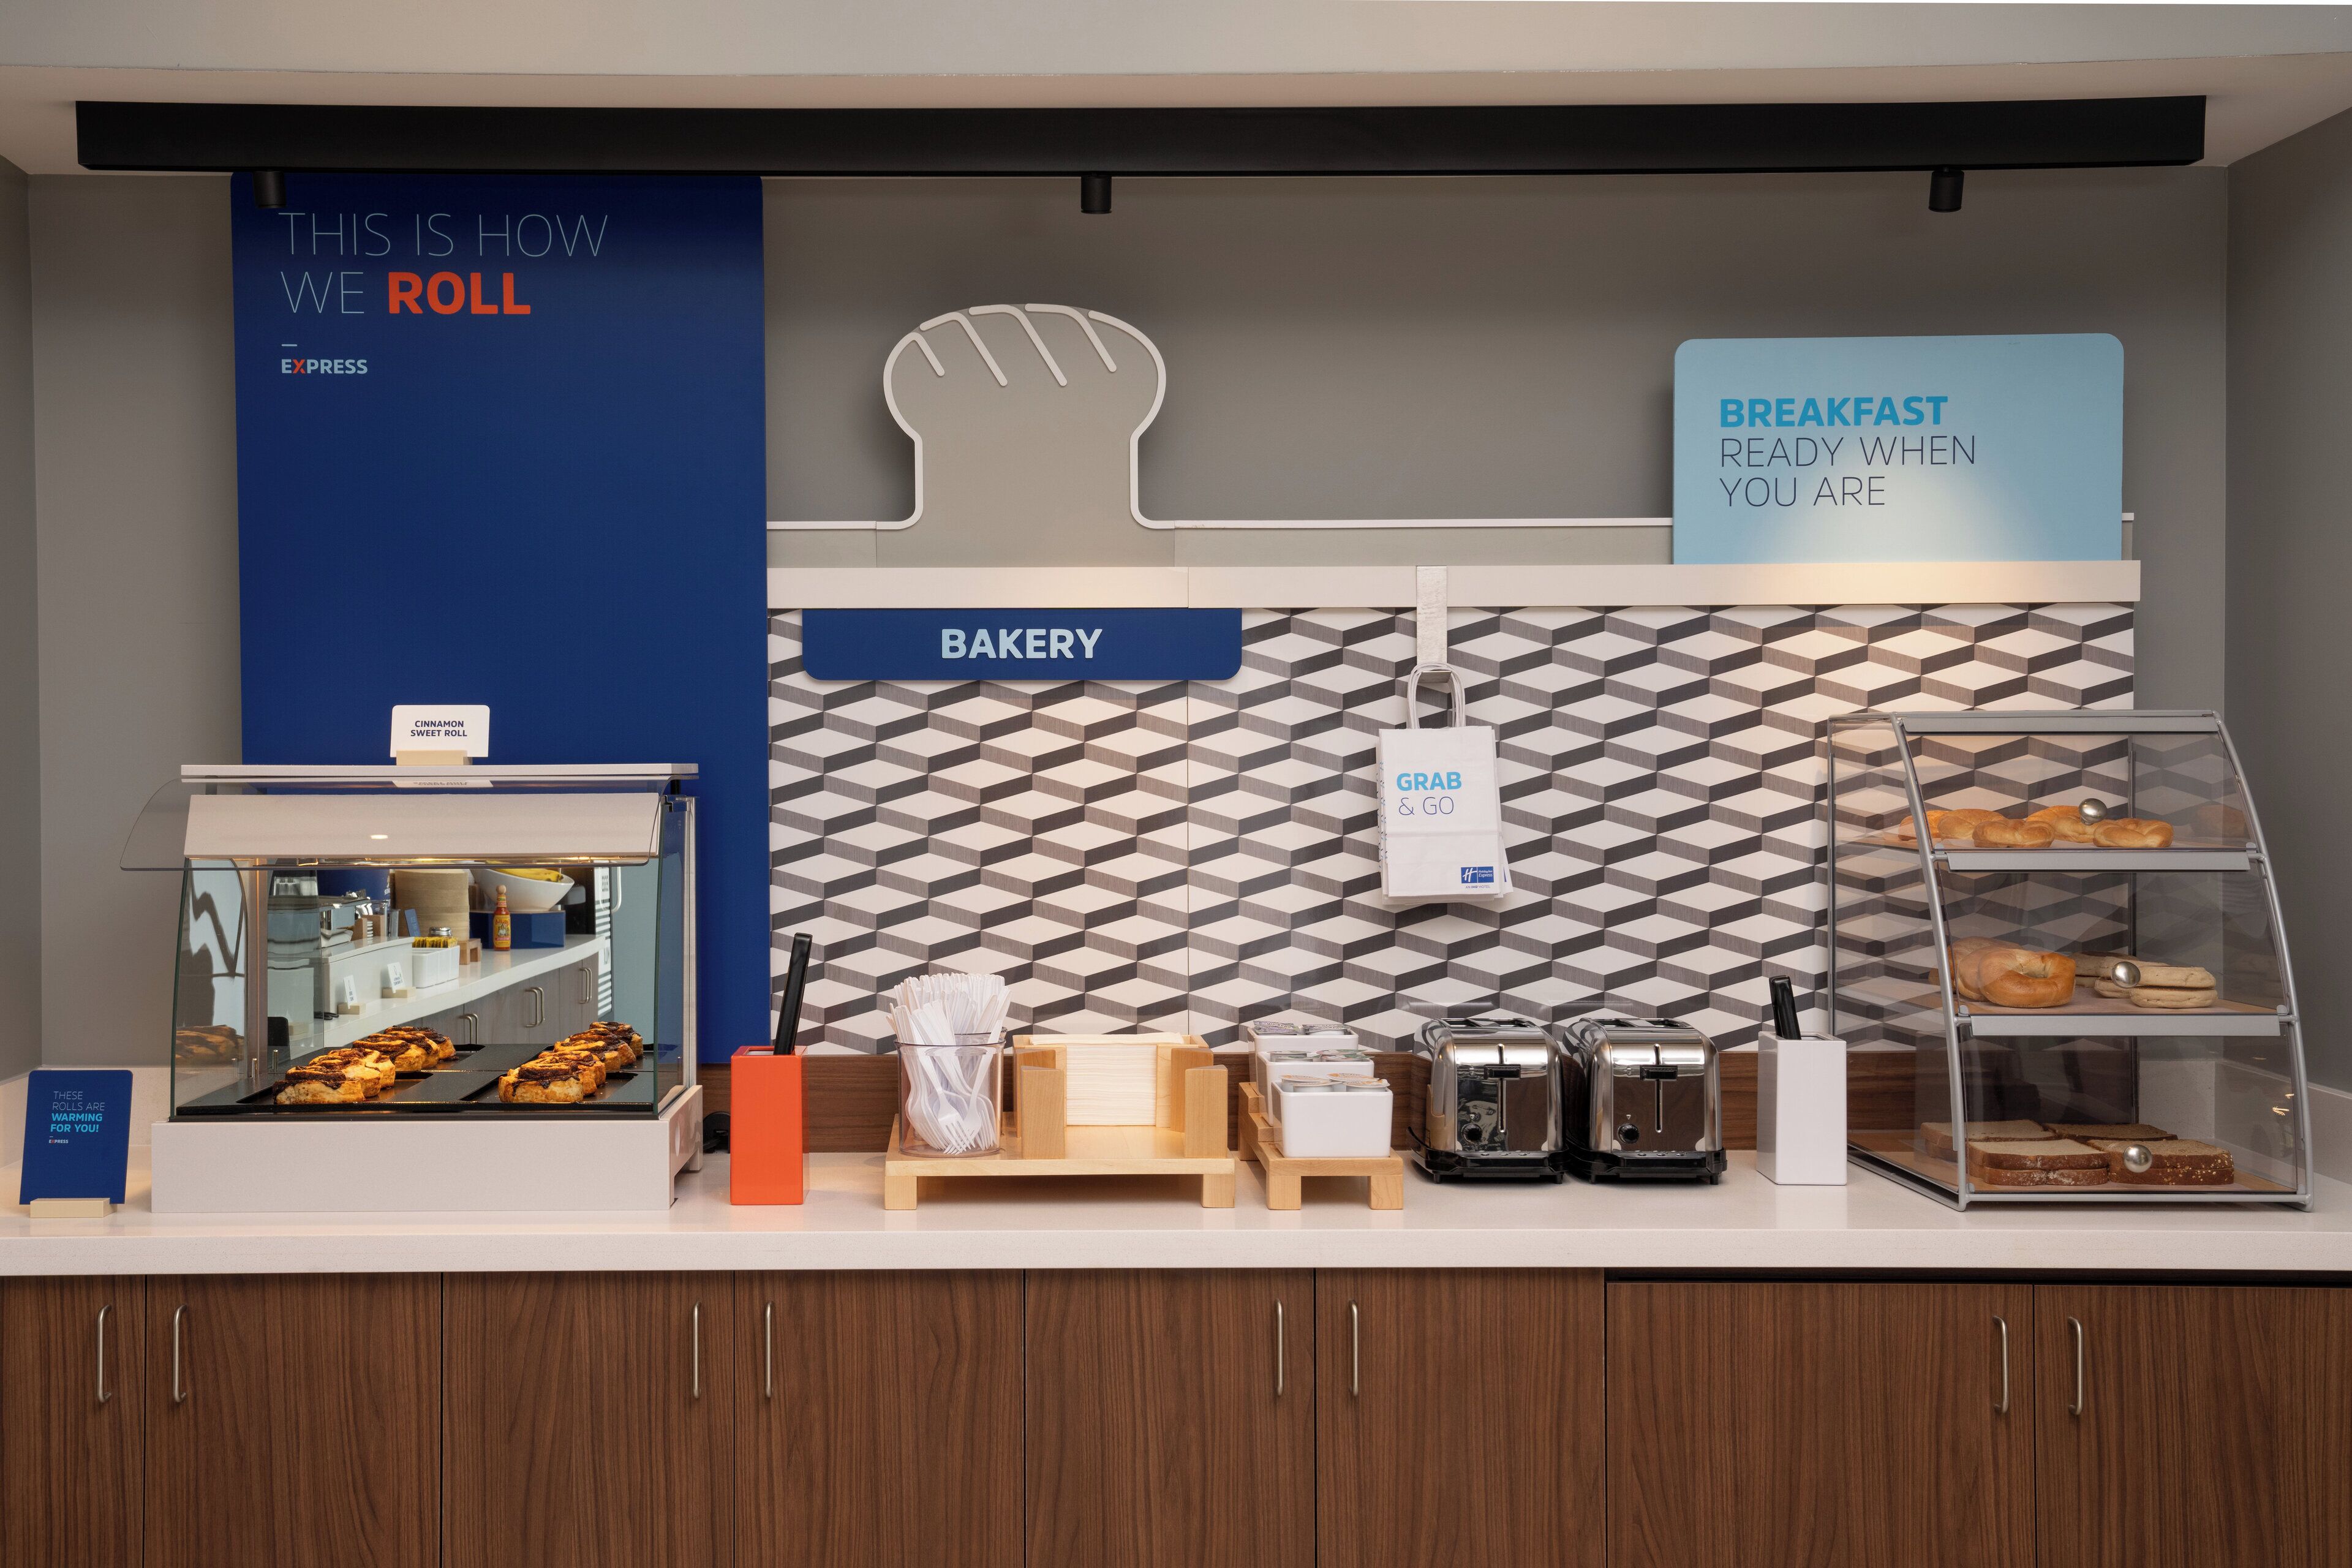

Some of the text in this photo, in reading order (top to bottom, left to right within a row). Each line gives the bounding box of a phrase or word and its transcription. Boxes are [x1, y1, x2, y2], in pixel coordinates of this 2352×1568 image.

[279, 213, 608, 257] THIS IS HOW
[281, 271, 531, 315] WE ROLL
[281, 358, 368, 374] EXPRESS
[1720, 396, 1948, 428] BREAKFAST
[1721, 435, 1975, 467] READY WHEN
[1719, 476, 1885, 507] YOU ARE
[941, 628, 1103, 659] BAKERY
[1396, 771, 1462, 791] GRAB
[1398, 796, 1454, 816] & GO
[53, 1091, 83, 1100] THESE
[52, 1102, 105, 1111] ROLLS ARE
[51, 1113, 103, 1121] WARMING
[50, 1124, 99, 1133] FOR YOU!
